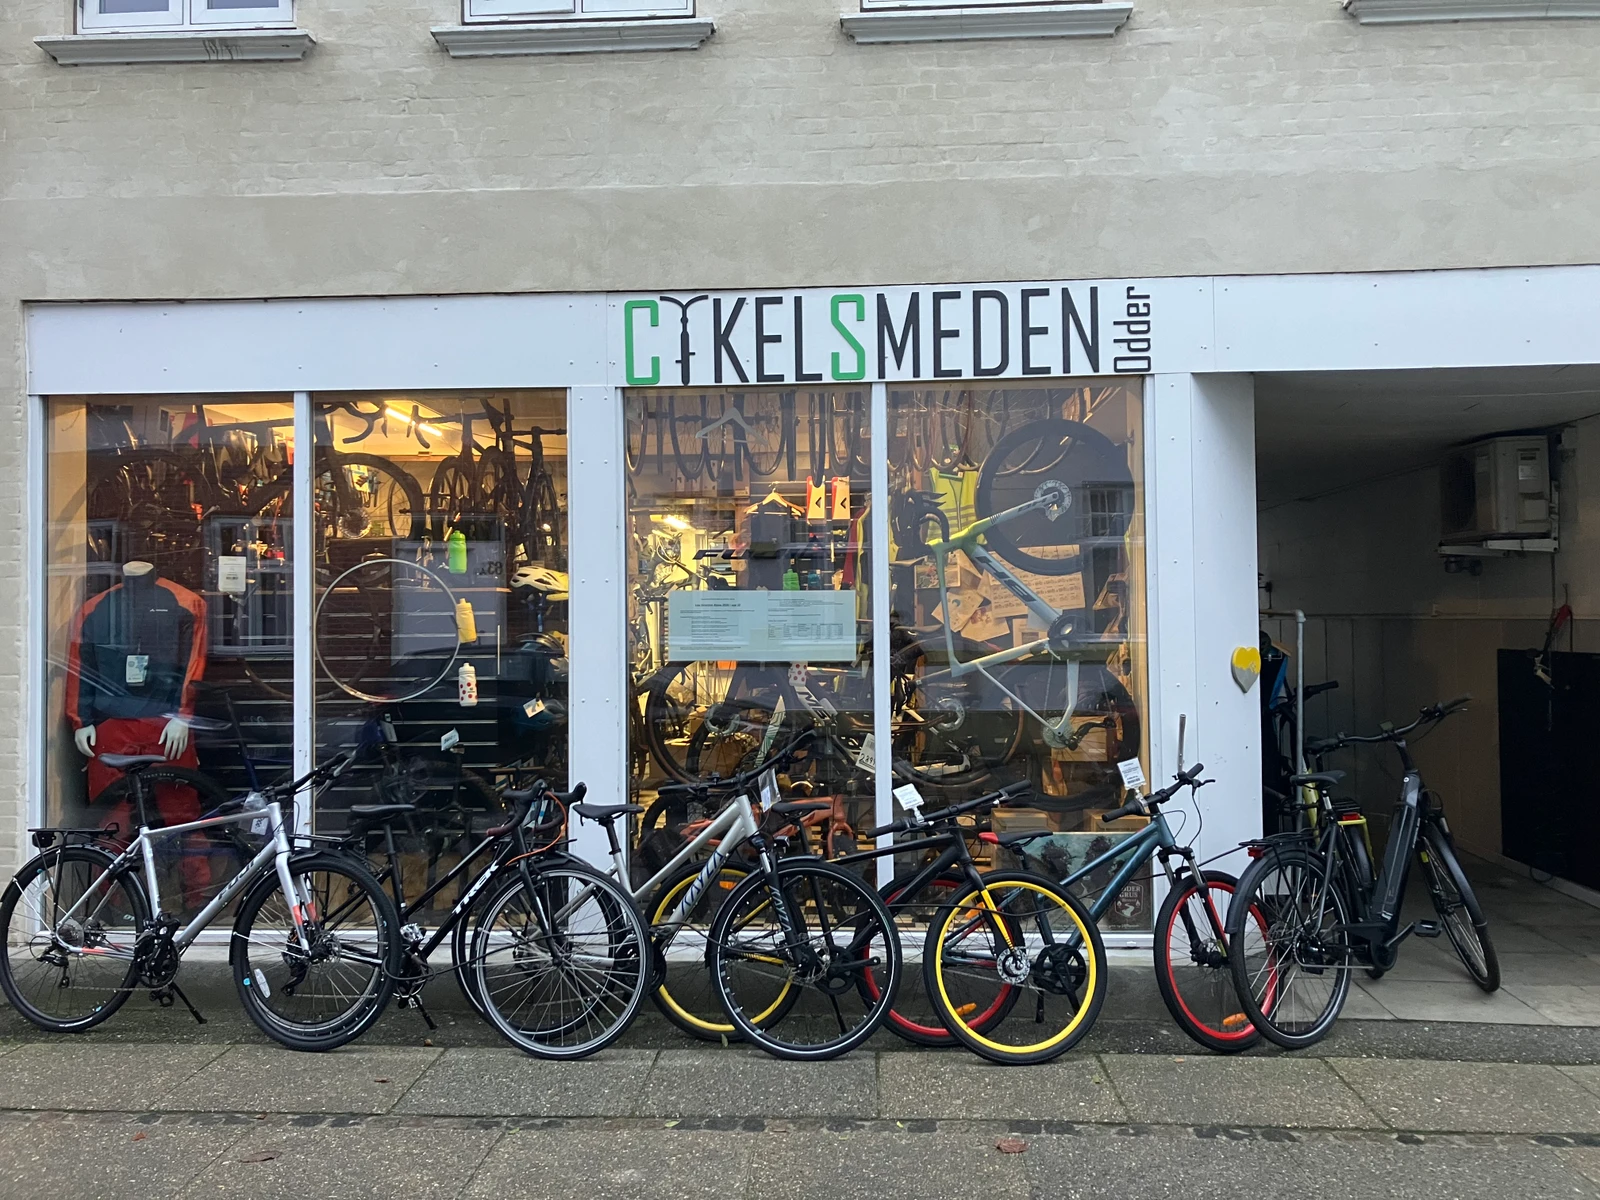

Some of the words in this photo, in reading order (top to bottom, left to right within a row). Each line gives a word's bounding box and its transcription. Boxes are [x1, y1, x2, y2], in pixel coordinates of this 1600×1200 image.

[624, 286, 1099, 385] CYKELSMEDEN
[1113, 286, 1151, 373] Odder
[451, 859, 499, 914] TREK
[681, 850, 724, 915] KAYZA
[768, 885, 792, 932] KAYZA
